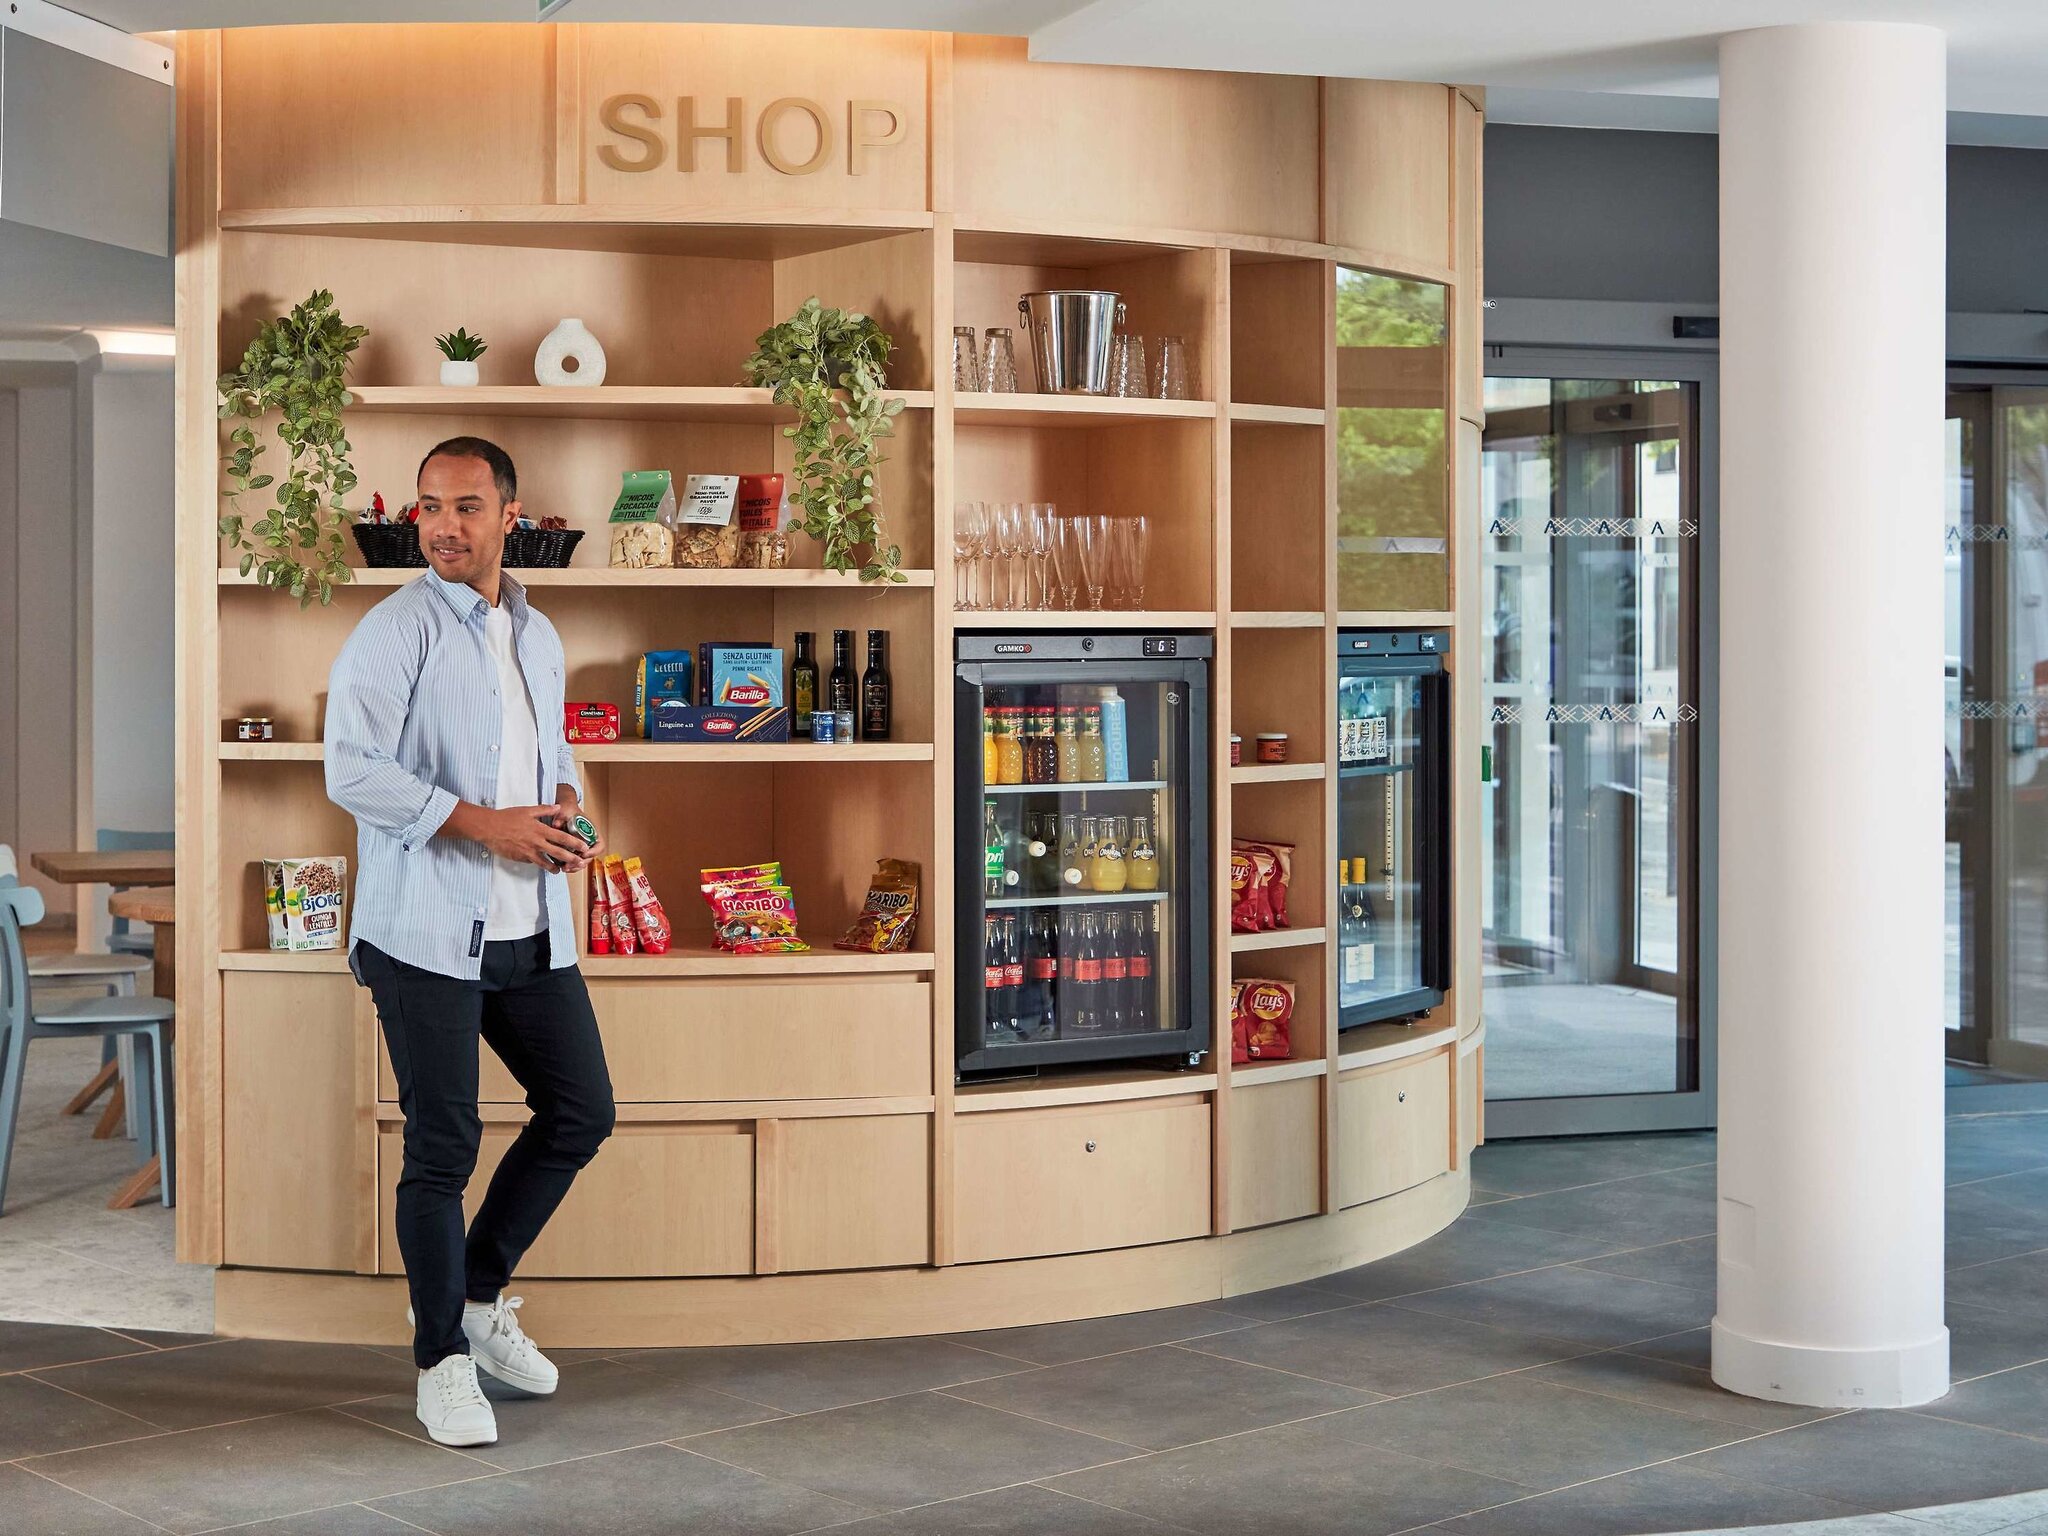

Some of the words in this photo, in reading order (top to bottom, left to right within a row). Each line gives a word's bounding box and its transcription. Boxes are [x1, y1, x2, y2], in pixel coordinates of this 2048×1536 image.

[597, 93, 906, 176] SHOP
[619, 501, 659, 510] FOCACCIAS
[624, 511, 647, 519] ITALIE
[748, 518, 772, 527] ITALIE
[997, 645, 1024, 653] GAMKO
[1157, 641, 1165, 652] 6
[722, 652, 744, 660] SENZA
[745, 652, 772, 660] GLUTINE
[730, 690, 765, 700] Barilla
[658, 721, 684, 729] Linguine
[706, 722, 734, 730] Barilla
[1361, 721, 1370, 756] SENLIS
[1377, 720, 1385, 754] SENLIS
[1231, 865, 1250, 881] ay's
[722, 896, 785, 912] HARIBO
[867, 890, 910, 908] HARIBO
[310, 912, 333, 923] QUINOA
[296, 940, 309, 950] BIO
[1253, 993, 1284, 1011] Lay's
